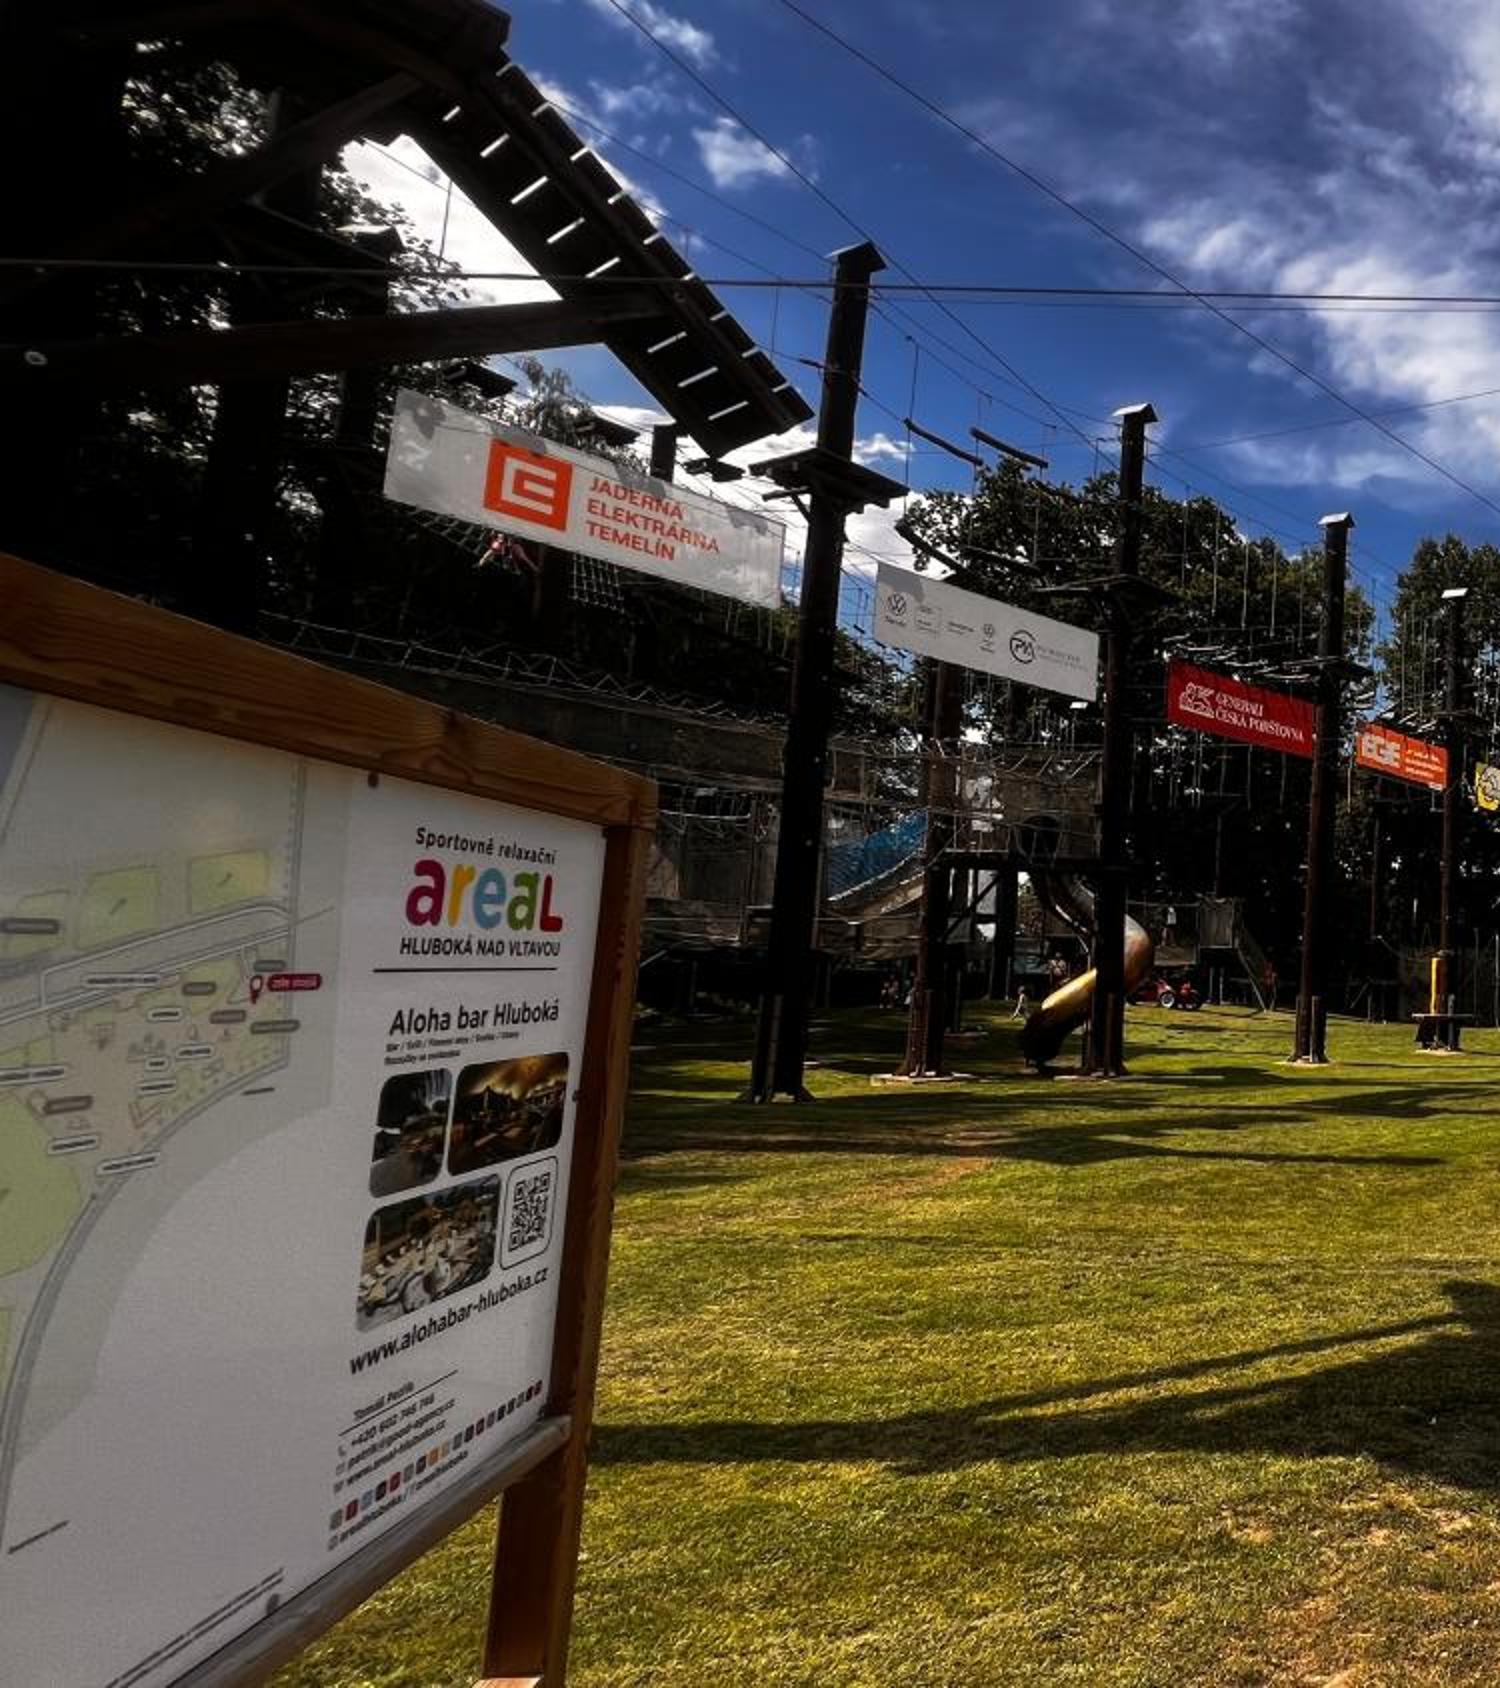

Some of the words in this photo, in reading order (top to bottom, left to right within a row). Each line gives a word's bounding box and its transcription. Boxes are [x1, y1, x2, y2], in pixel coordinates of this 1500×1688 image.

[590, 477, 683, 521] JADERNÁ
[584, 520, 675, 561] TEMELÍN
[586, 498, 720, 553] ELEKTRÁRNA
[399, 934, 473, 956] HLUBOKÁ
[475, 940, 505, 956] NAD
[508, 940, 561, 957] VLTAVOU
[388, 1007, 451, 1036] Aloha
[456, 1003, 489, 1030] bar
[492, 998, 560, 1027] Hluboká
[349, 1267, 550, 1375] www.alohabar-hluboka.cz
